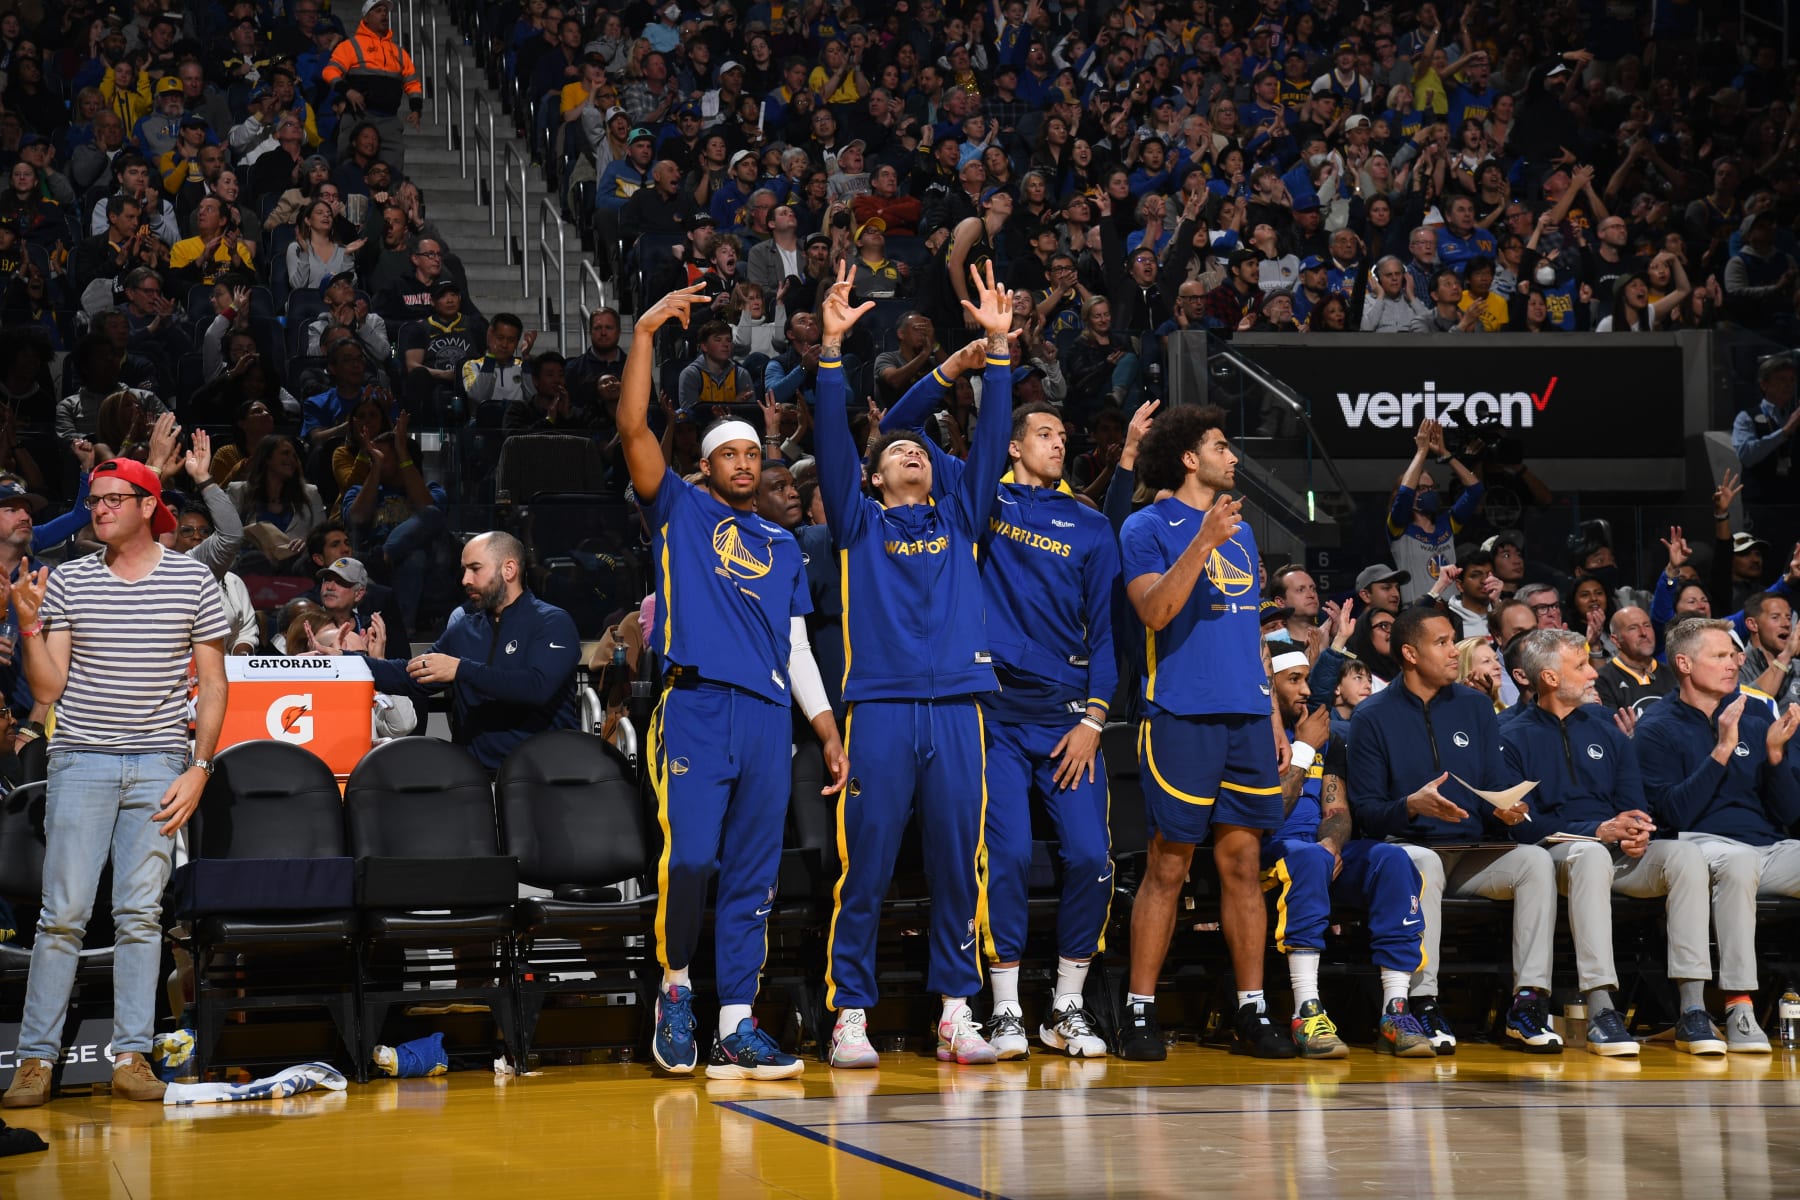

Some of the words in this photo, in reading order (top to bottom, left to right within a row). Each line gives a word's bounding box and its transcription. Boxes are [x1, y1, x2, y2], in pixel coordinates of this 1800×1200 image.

[427, 337, 470, 352] TOWN
[1336, 380, 1534, 428] verizon
[1051, 518, 1076, 528] Rakuten
[989, 516, 1071, 557] WARRIORS
[1318, 551, 1330, 567] 6
[1319, 574, 1330, 590] 5
[248, 659, 332, 669] GATORADE
[265, 693, 314, 746] G
[0, 1044, 99, 1069] CSE
